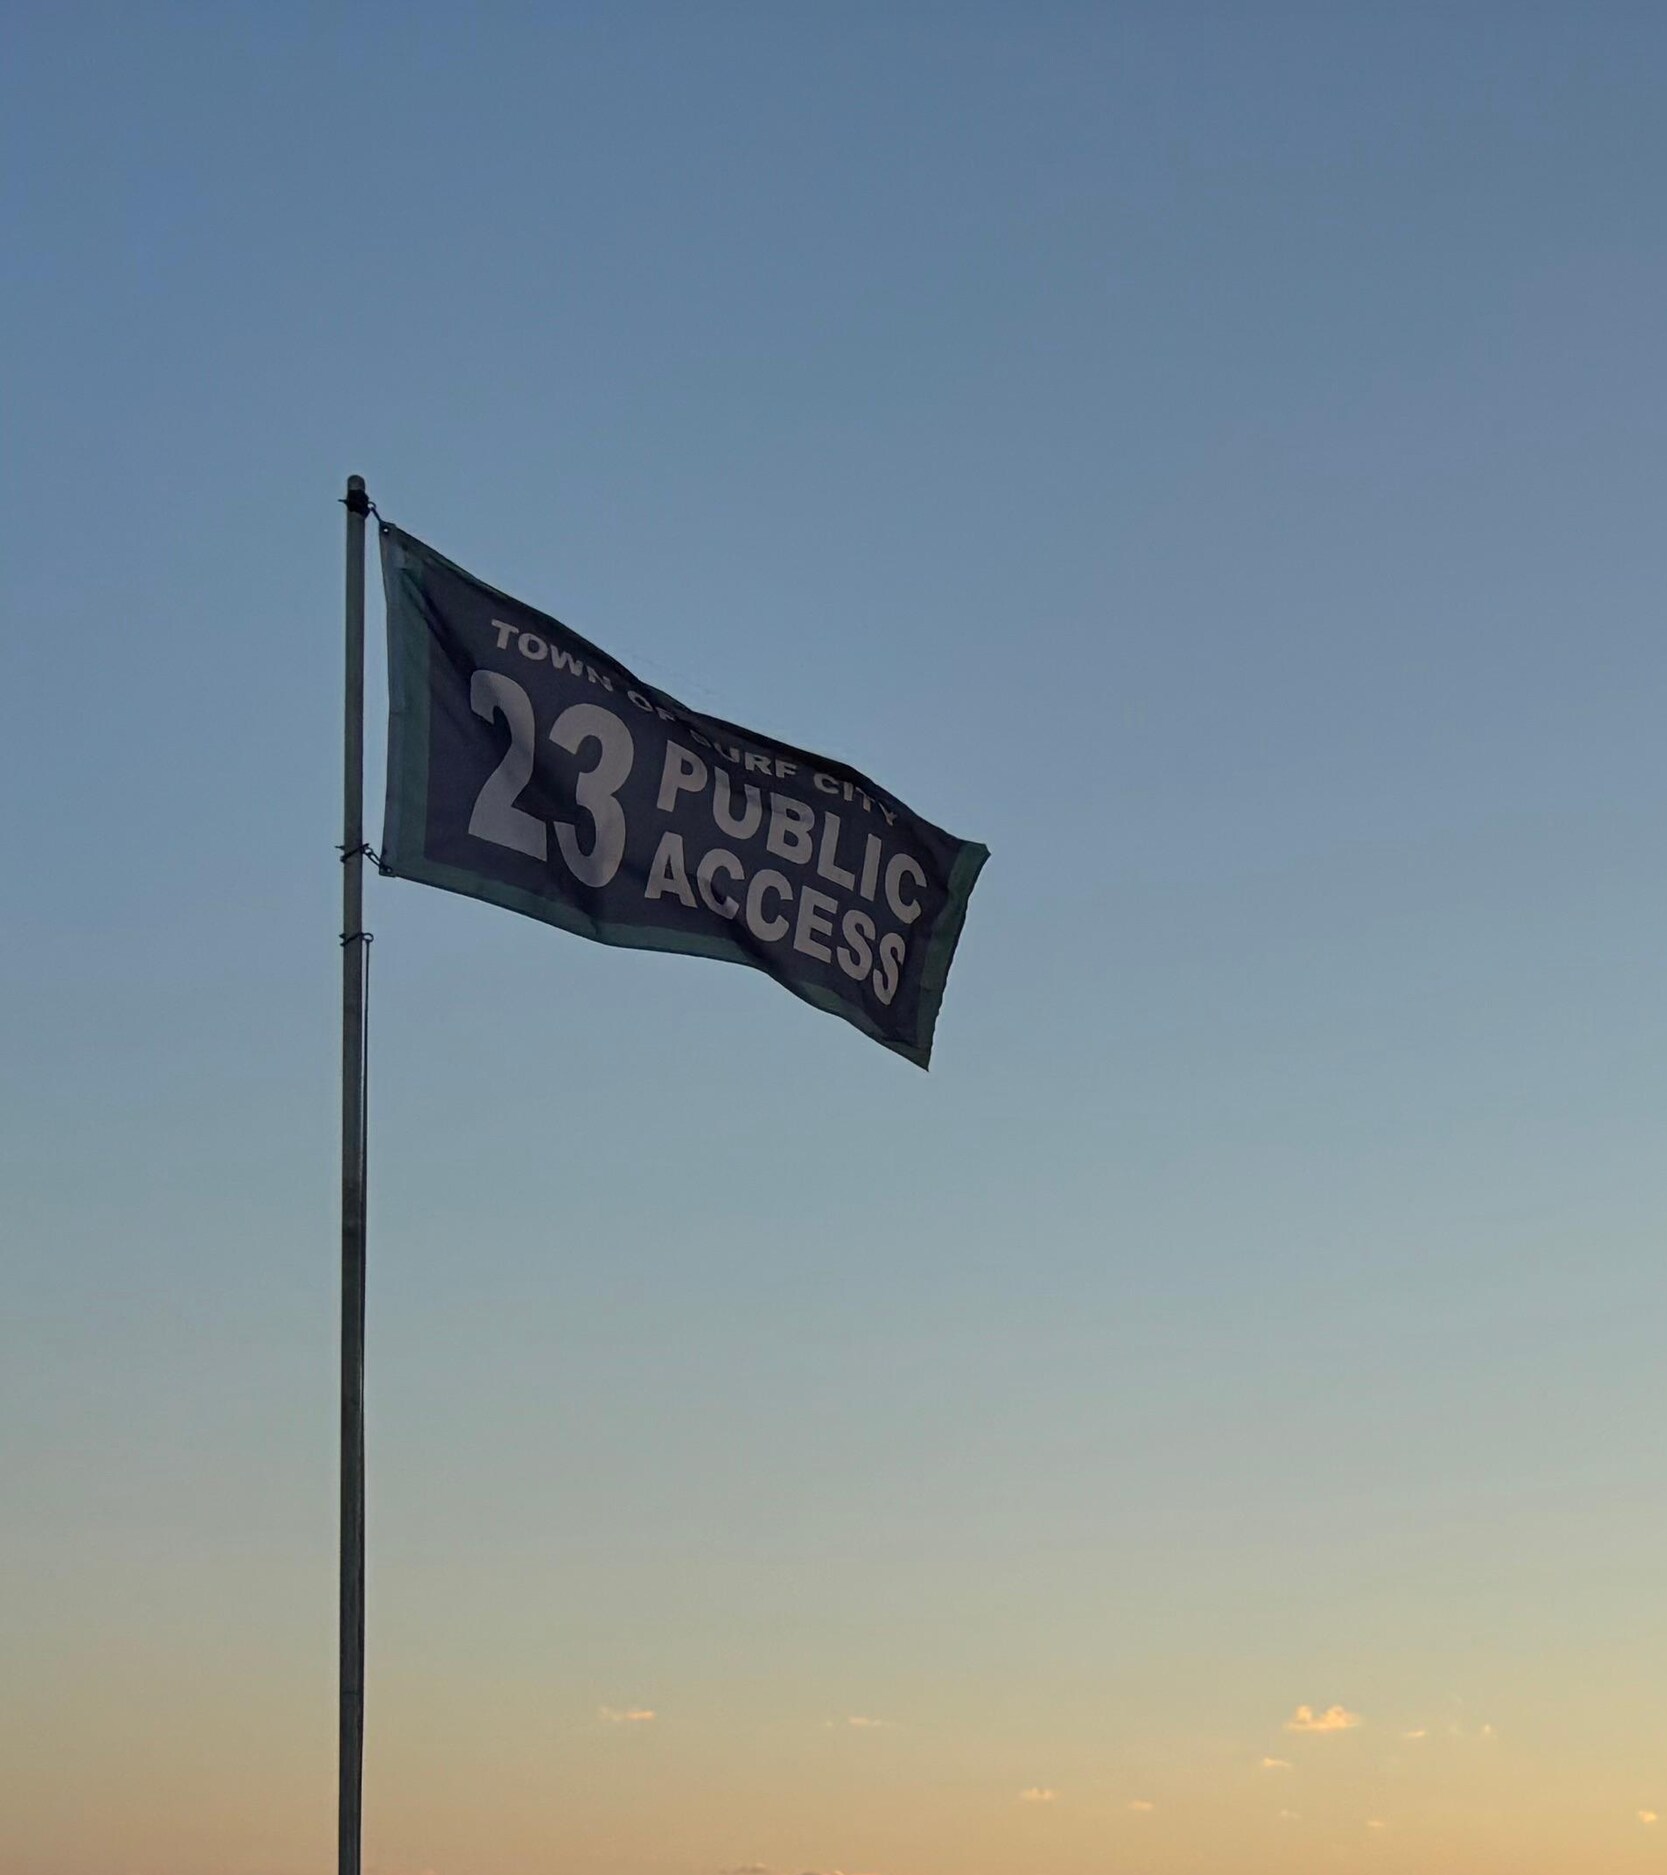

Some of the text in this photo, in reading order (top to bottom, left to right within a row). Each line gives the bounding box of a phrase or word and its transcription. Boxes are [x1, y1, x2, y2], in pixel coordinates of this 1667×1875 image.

[468, 669, 634, 888] 23
[491, 619, 614, 692] TOWN
[627, 690, 676, 722] OF
[813, 772, 898, 826] CITY
[645, 832, 906, 1006] ACCESS
[656, 740, 927, 924] PUBLIC
